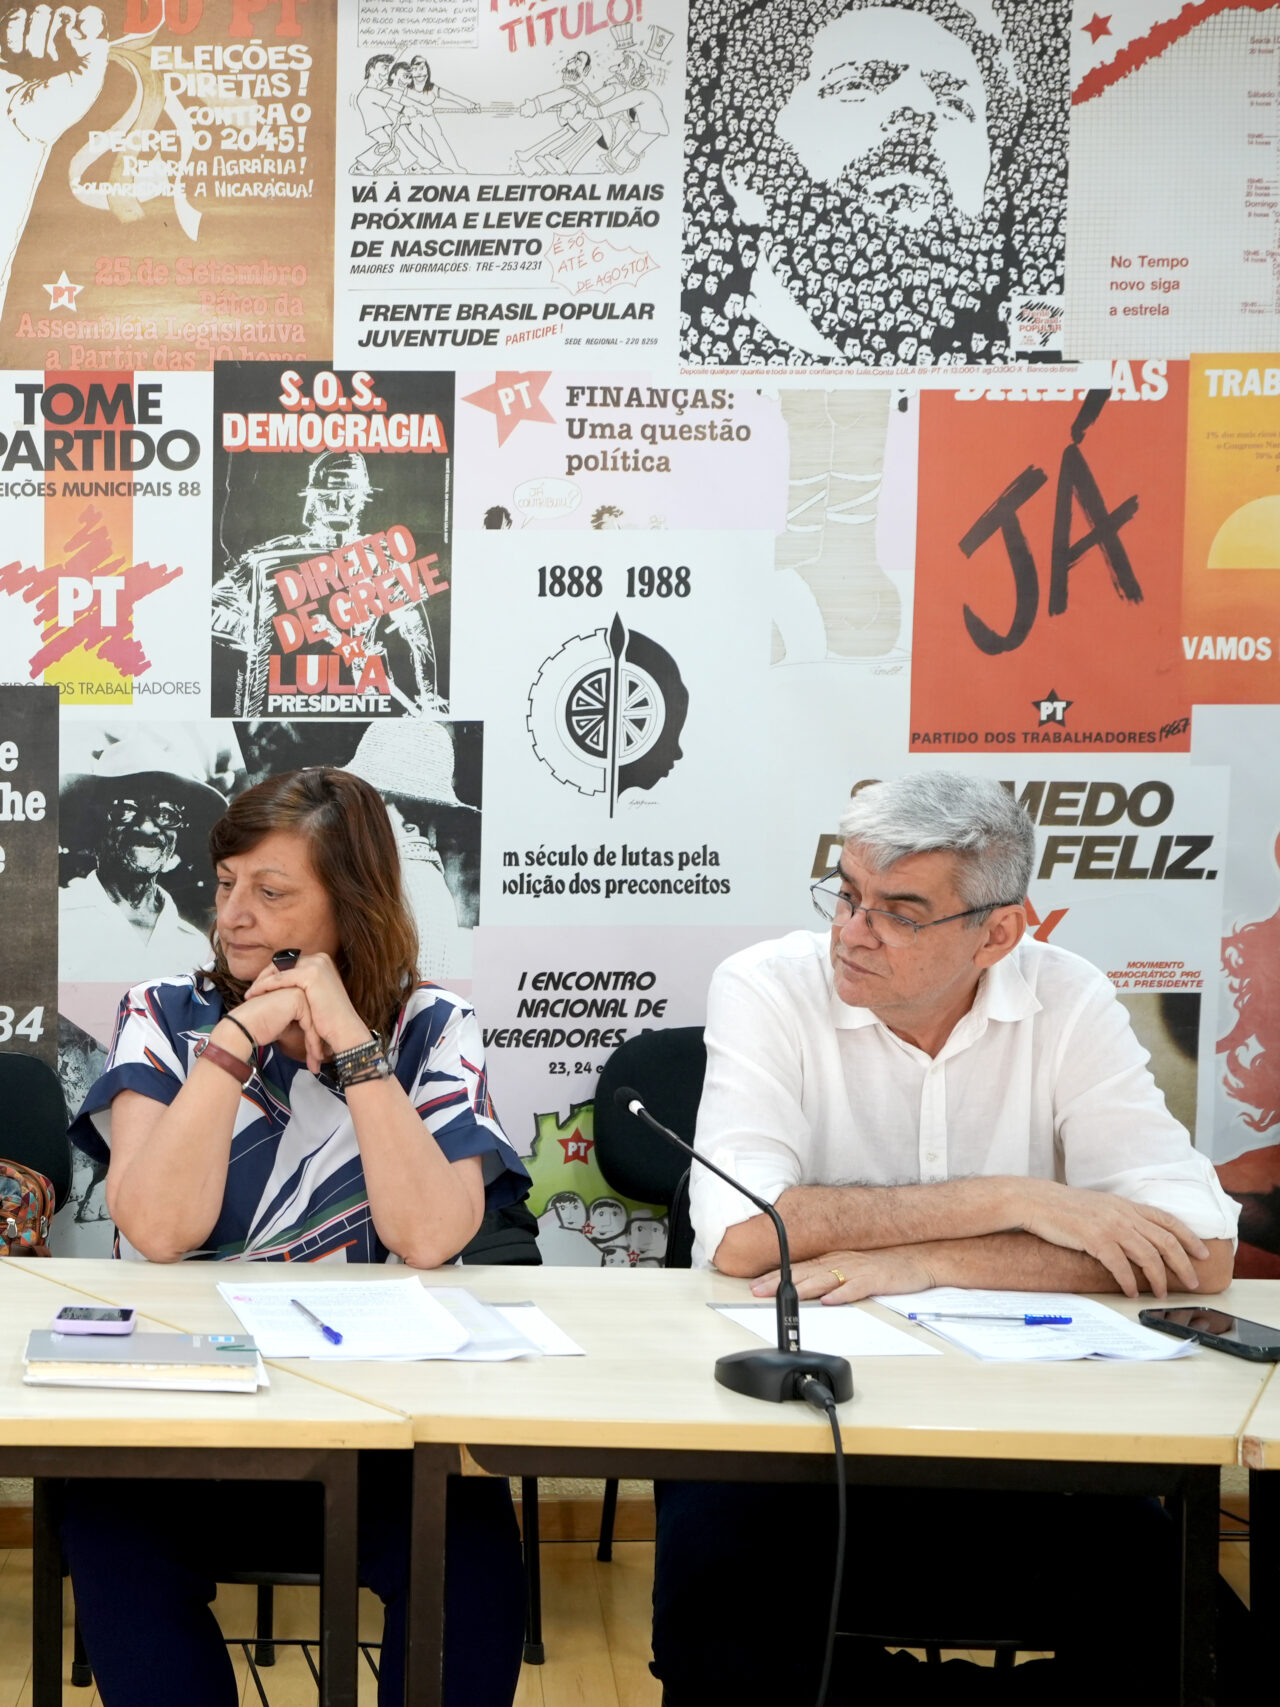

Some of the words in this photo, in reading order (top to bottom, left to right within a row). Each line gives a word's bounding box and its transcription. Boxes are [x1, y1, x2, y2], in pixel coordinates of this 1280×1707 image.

[500, 0, 643, 53] TÍTULO!
[150, 40, 312, 71] ELEIÇÕES
[186, 104, 286, 126] CONTRA
[290, 103, 312, 124] O
[89, 128, 212, 153] DECRETO
[220, 126, 306, 153] 2045!
[214, 178, 314, 199] NICARÁGUA!
[352, 181, 378, 203] VÁ
[407, 185, 471, 203] ZONA
[476, 184, 601, 203] ELEITORAL
[606, 183, 665, 202] MAIS
[350, 207, 457, 230] PRÓXIMA
[462, 211, 480, 229] E
[483, 210, 543, 230] LEVE
[545, 206, 660, 229] CERTIDÃO
[350, 240, 385, 259] DE
[391, 238, 543, 259] NASCIMENTO
[94, 257, 132, 287] 25
[136, 258, 169, 287] de
[175, 257, 307, 287] Setembro
[350, 263, 395, 275] MAIORES
[399, 260, 472, 276] INFORMAÇÕES:
[1110, 255, 1132, 269] No
[1138, 255, 1190, 272] Tempo
[1109, 279, 1145, 291] novo
[1151, 278, 1181, 294] siga
[274, 289, 304, 315] da
[358, 303, 450, 322] FRENTE
[456, 302, 538, 321] BRASIL
[542, 302, 655, 321] POPULAR
[1122, 303, 1170, 316] estrela
[16, 312, 158, 341] Assembléia
[165, 316, 305, 350] Legislativa
[358, 328, 500, 348] JUVENTUDE
[278, 369, 388, 412] S.O.S.
[498, 380, 532, 416] PT
[565, 385, 735, 416] FINANÇAS:
[15, 383, 163, 425] TOME
[222, 412, 449, 453] DEMOCRACIA
[565, 418, 633, 440] Uma
[640, 419, 751, 445] questão
[565, 447, 671, 476] política
[61, 480, 172, 497] MUNICIPAIS
[177, 480, 202, 497] 88
[958, 389, 1144, 656] JÁ
[537, 565, 603, 598] 1888
[626, 565, 692, 598] 1988
[57, 576, 125, 627] PT
[1182, 636, 1272, 661] VAMOS
[267, 653, 391, 695] LULA
[78, 682, 201, 695] TRABALHADORES
[268, 695, 391, 713] PRESIDENTE
[1039, 702, 1067, 721] PT
[911, 731, 978, 746] PARTIDO
[984, 731, 1016, 744] DOS
[1021, 730, 1157, 745] TRABALHADORES
[524, 843, 589, 868] século
[593, 844, 617, 867] de
[620, 844, 674, 867] lutas
[677, 844, 721, 871] pela
[1037, 835, 1219, 881] FELIZ.
[569, 872, 601, 895] dos
[604, 872, 732, 899] preconceitos
[1107, 969, 1177, 979] DEMOCRÁTICO
[1126, 961, 1185, 970] MOVIMENTO
[531, 970, 657, 991] ENCONTRO
[1133, 979, 1204, 988] PRESIDENTE
[516, 998, 629, 1019] NACIONAL
[634, 998, 669, 1019] DE
[482, 1028, 627, 1049] VEREADORES
[567, 1141, 588, 1157] PT
